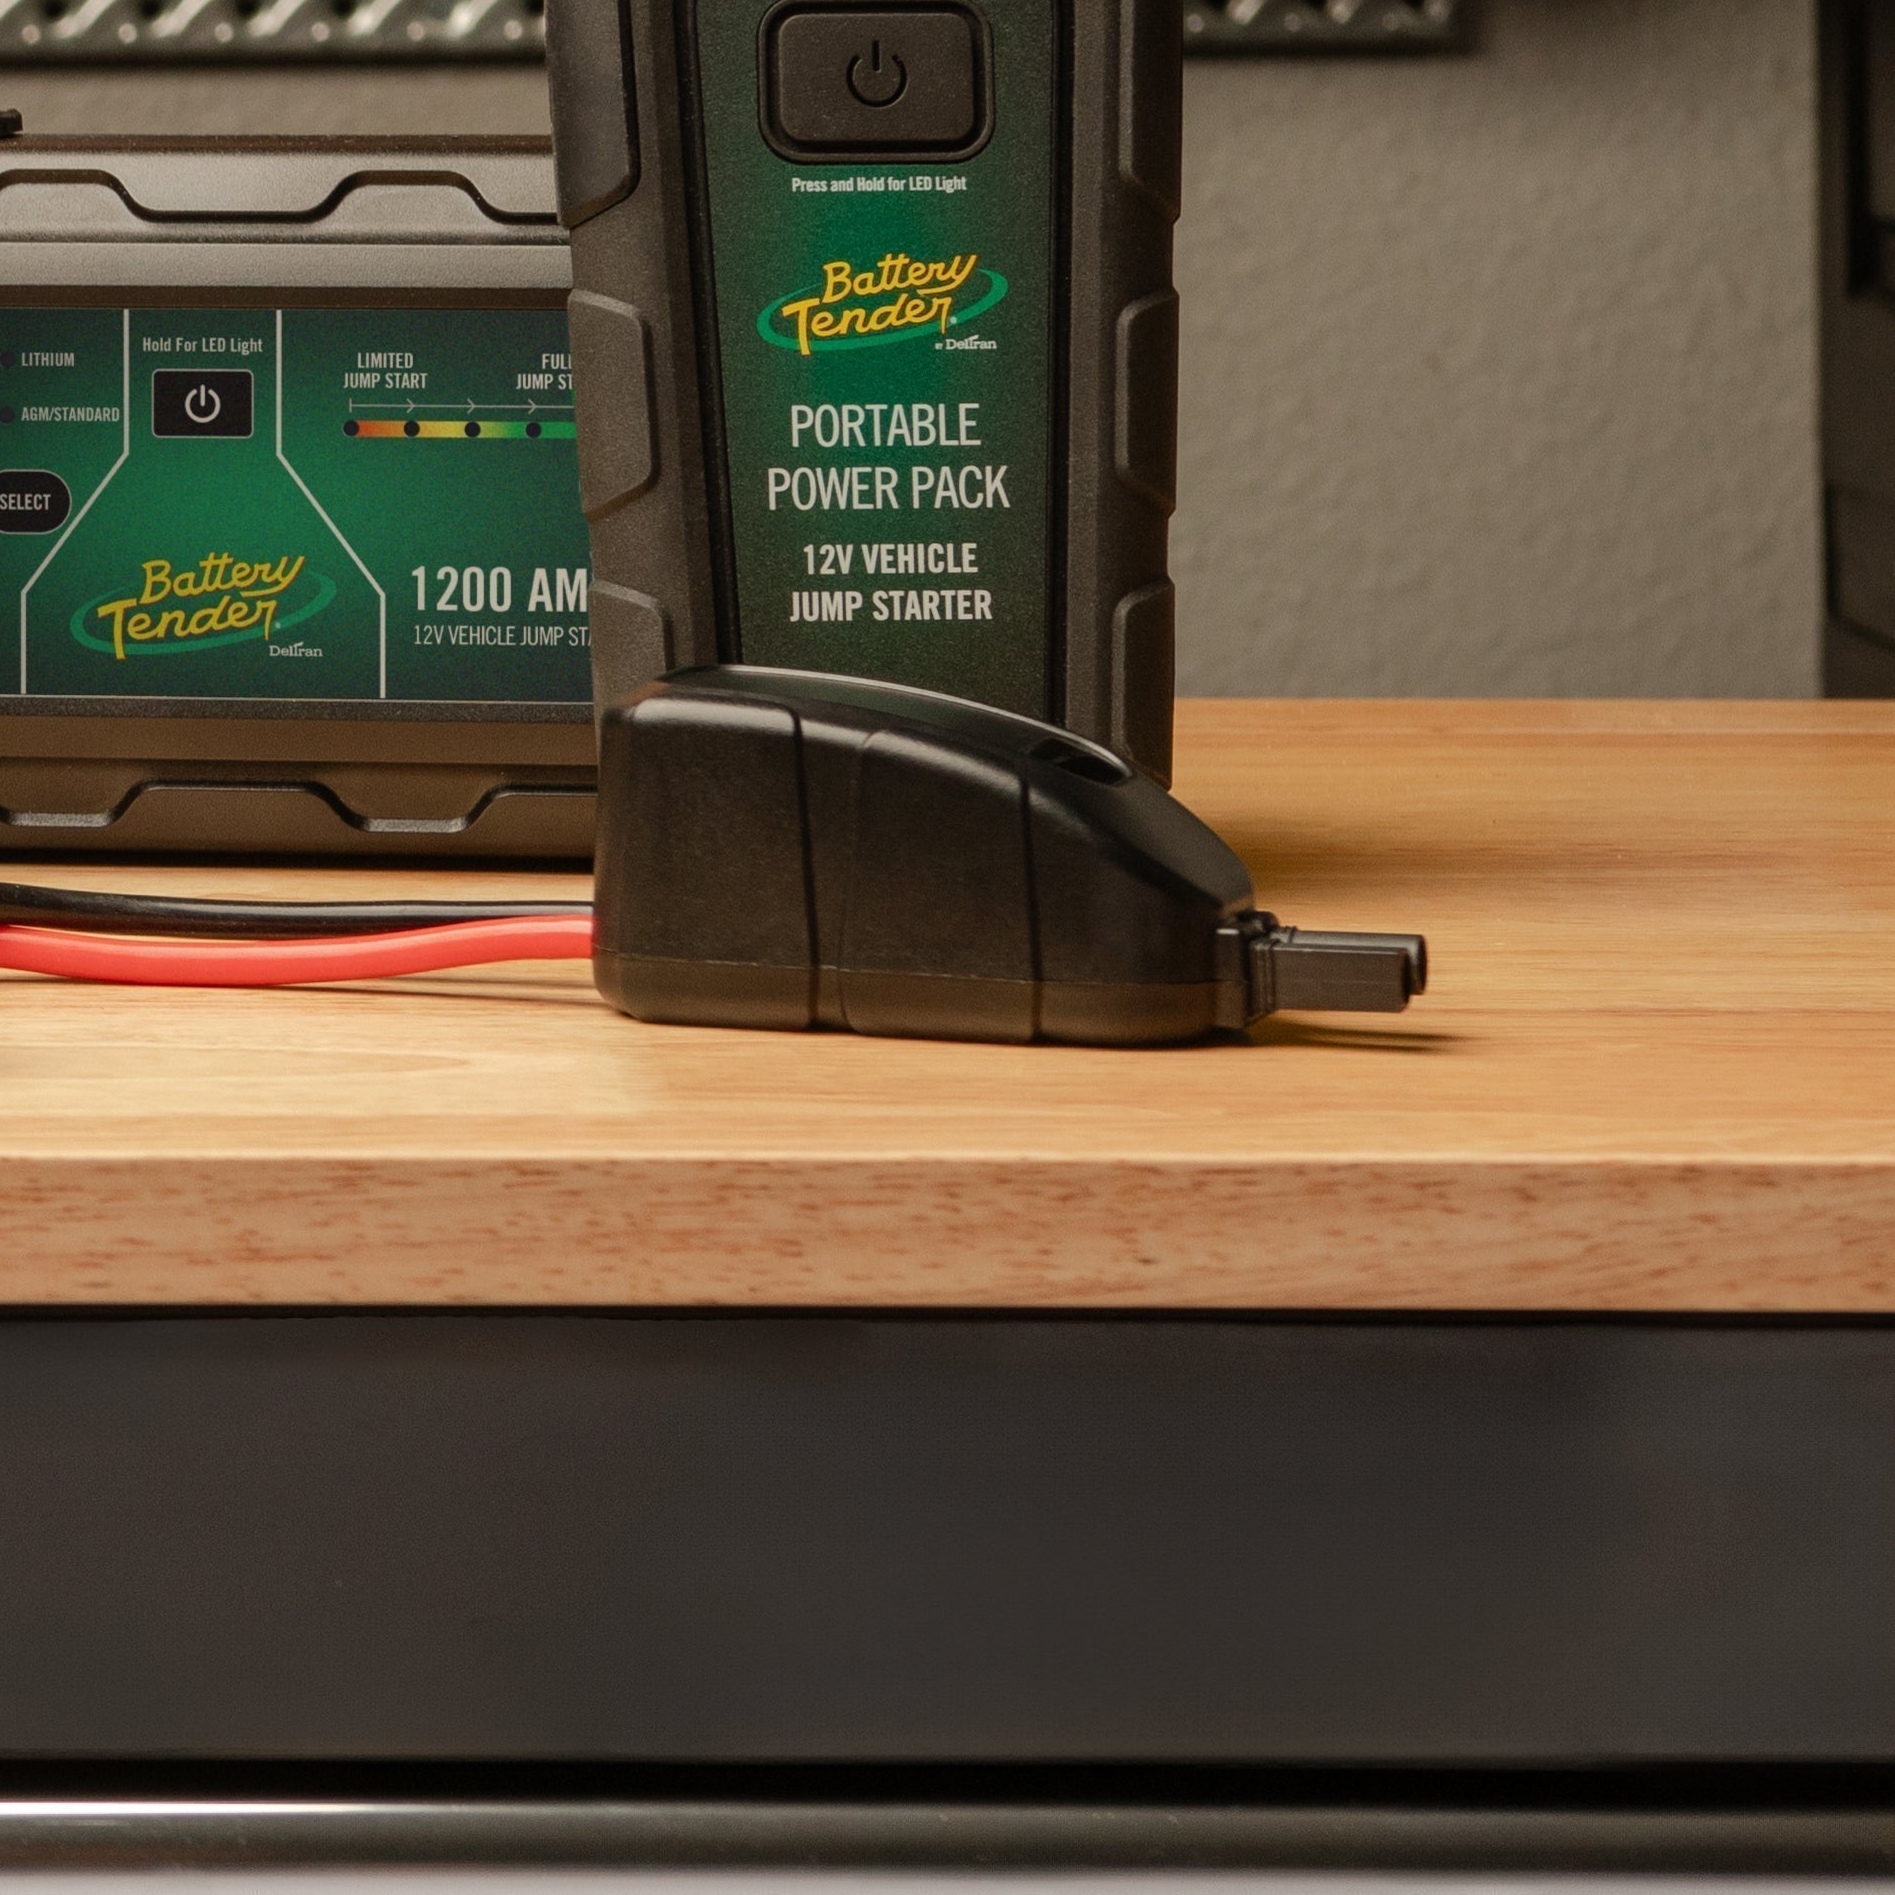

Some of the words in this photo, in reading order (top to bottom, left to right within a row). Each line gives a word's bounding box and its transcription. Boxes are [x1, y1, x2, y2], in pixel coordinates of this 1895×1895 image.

[791, 177, 828, 193] Press
[830, 177, 854, 193] and
[856, 177, 885, 192] Hold
[887, 177, 907, 192] for
[909, 177, 932, 192] LED
[935, 177, 967, 193] Light
[821, 252, 978, 303] Battery
[782, 290, 953, 356] Tender
[21, 352, 75, 368] LITHIUM
[142, 337, 172, 353] Hold
[176, 337, 198, 353] For
[201, 337, 225, 353] LED
[229, 337, 263, 355] Light
[357, 352, 414, 369] LIMITED
[343, 372, 382, 389] JUMP
[384, 372, 428, 390] START
[516, 373, 554, 390] JUMP
[21, 407, 120, 423] AGM/STANDARD
[790, 403, 982, 447] PORTABLE
[768, 466, 899, 511] POWER
[911, 465, 1010, 508] PACK
[803, 543, 854, 575] 12V
[861, 542, 979, 574] VEHICLE
[140, 552, 306, 604] Battery
[411, 565, 512, 613] 1200
[527, 568, 588, 613] AM
[790, 591, 862, 622] JUMP
[872, 589, 992, 621] STARTER
[97, 597, 279, 660] Tender
[413, 625, 445, 646] 12V
[448, 625, 516, 647] VEHICLE
[520, 625, 564, 646] JUMP
